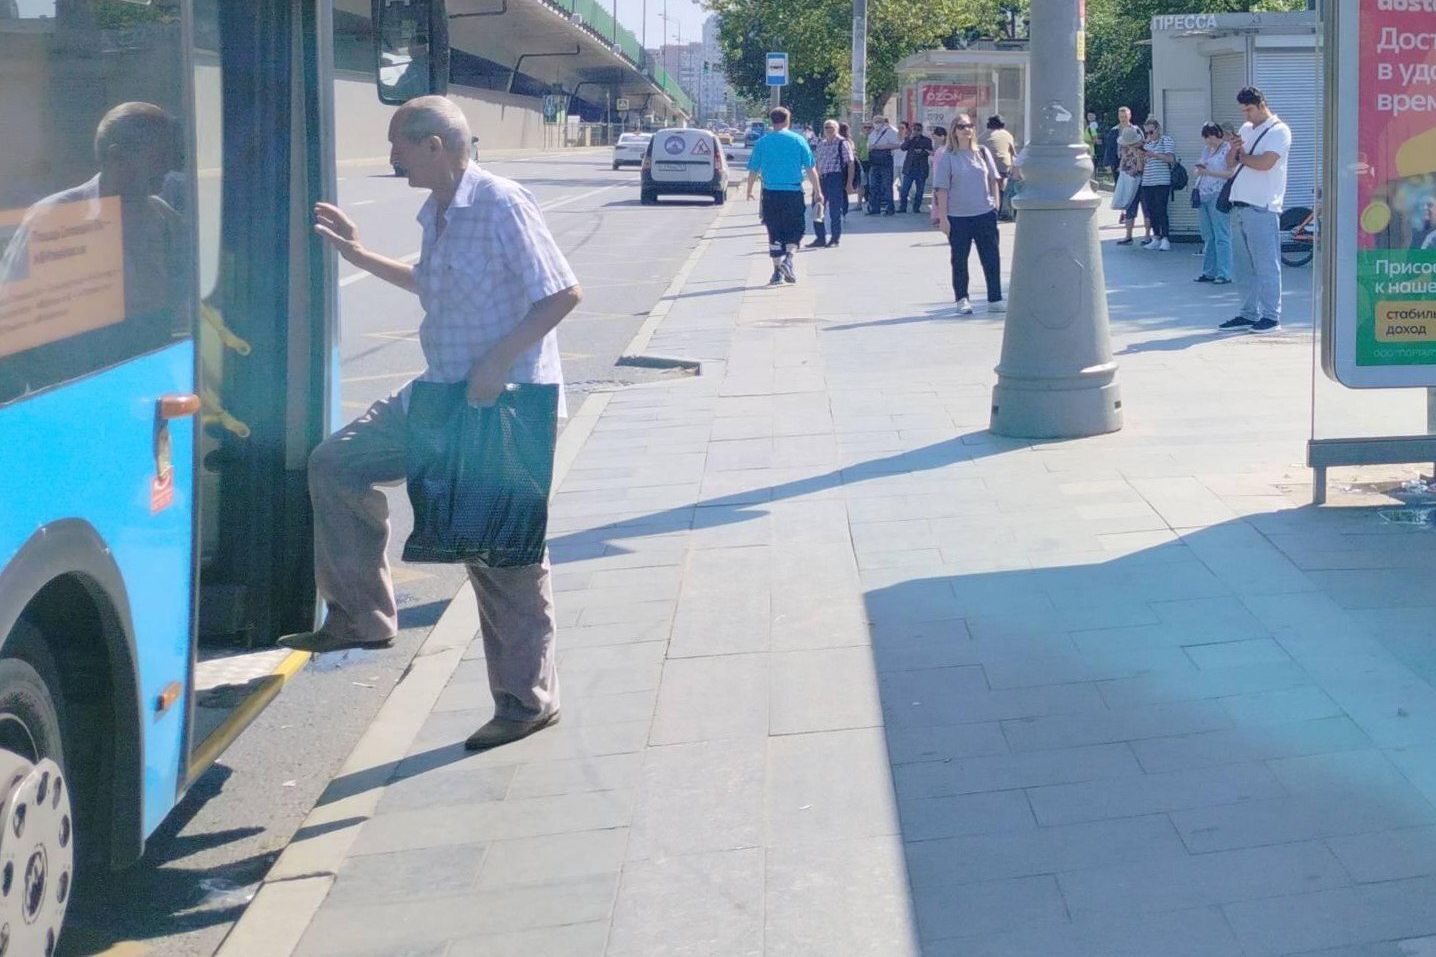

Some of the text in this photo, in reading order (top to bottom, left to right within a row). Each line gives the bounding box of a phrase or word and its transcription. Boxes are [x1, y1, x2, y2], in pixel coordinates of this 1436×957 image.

[1150, 13, 1218, 30] ПРЕССА
[1377, 63, 1393, 80] в
[1375, 281, 1385, 293] к
[1385, 324, 1427, 336] доход
